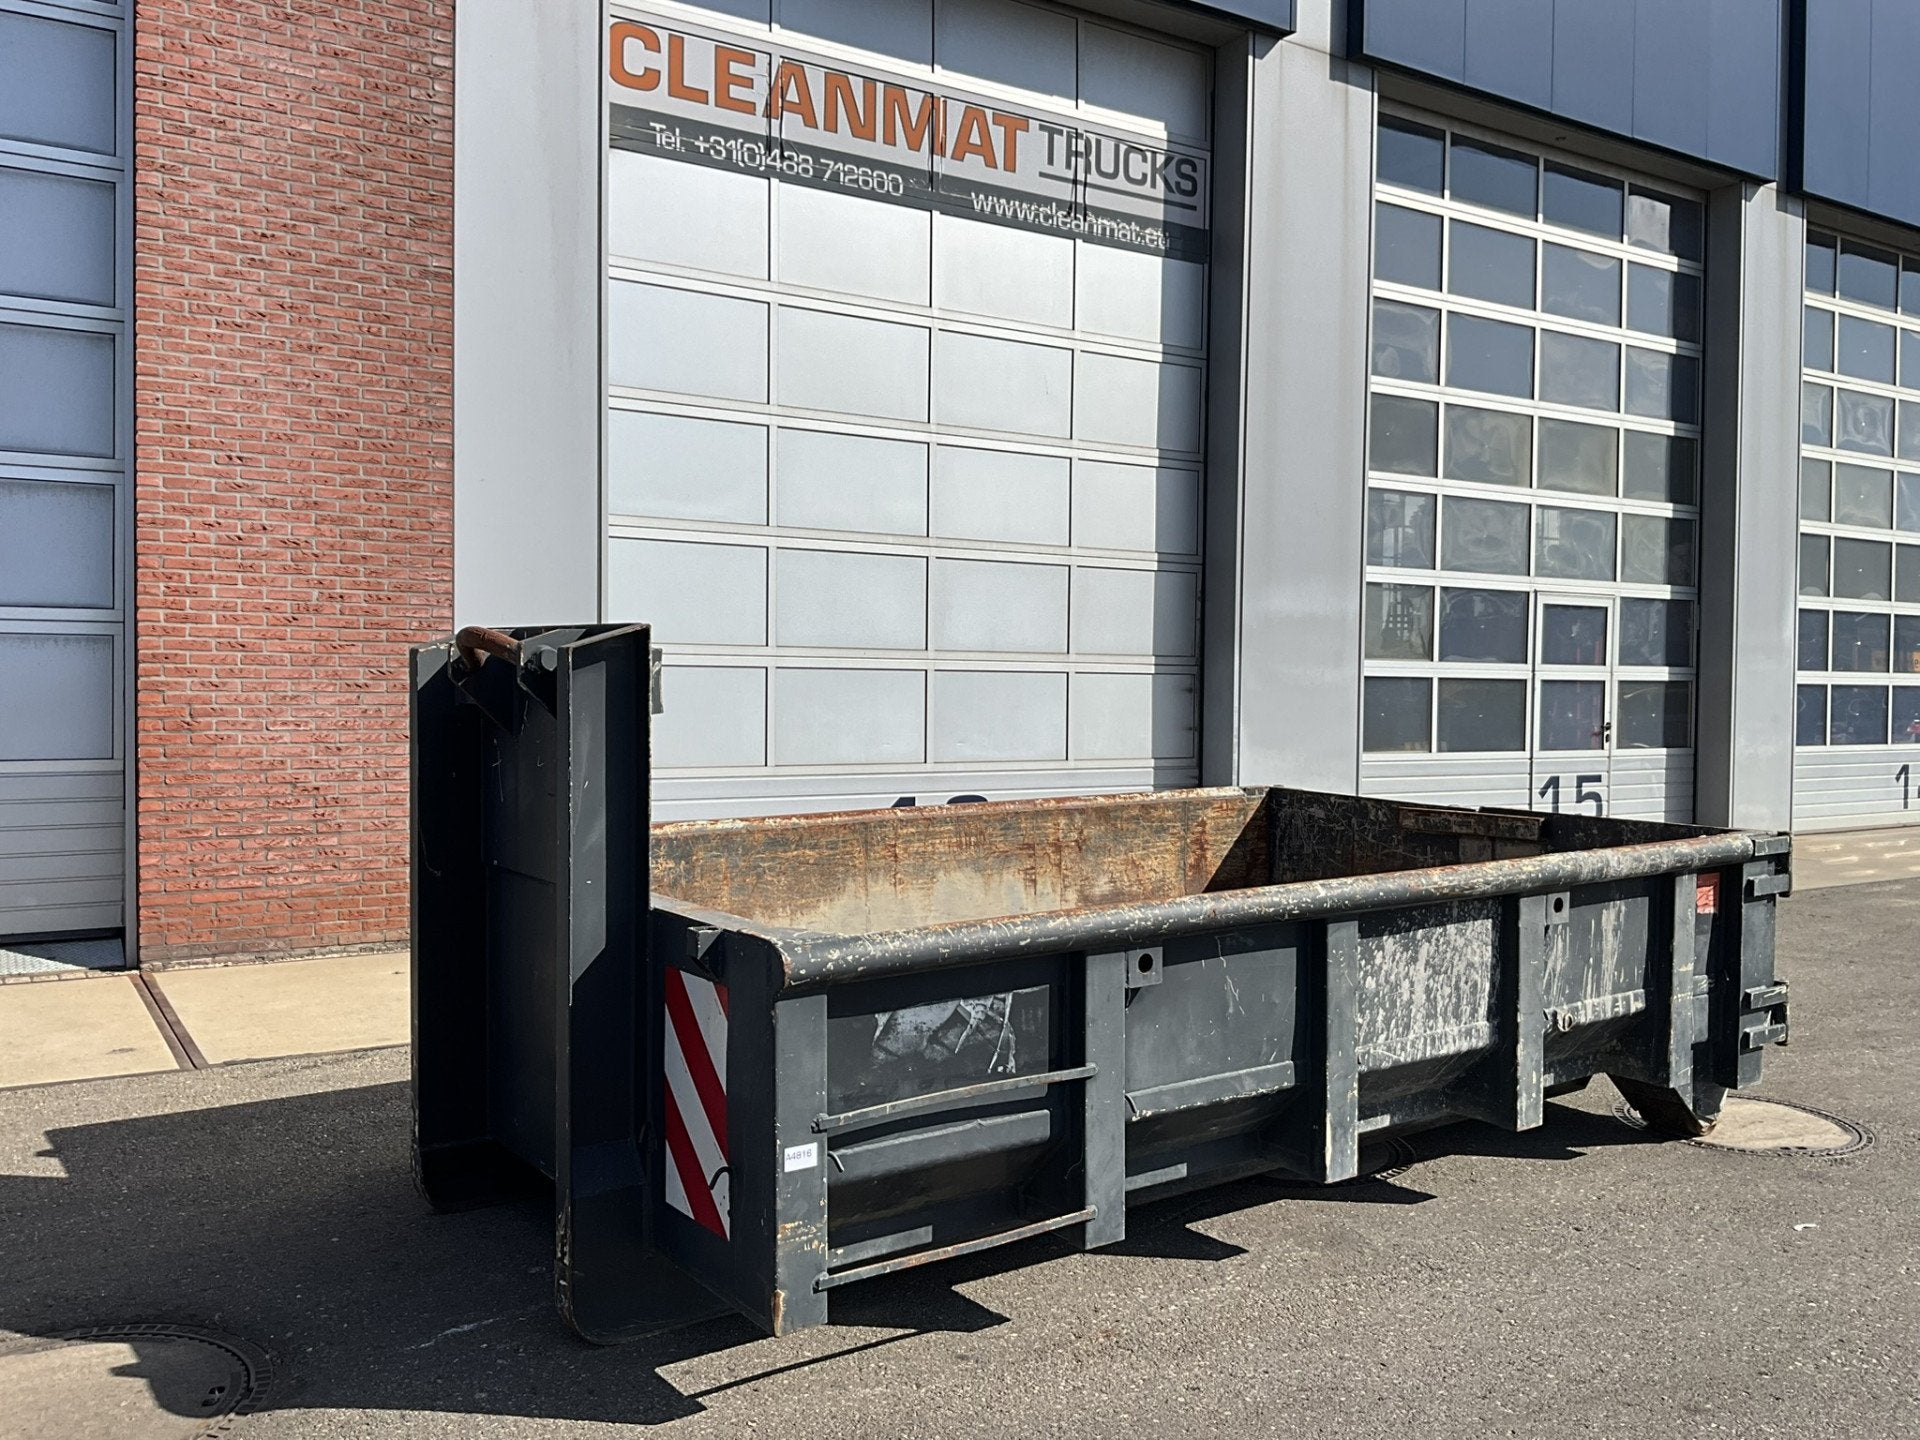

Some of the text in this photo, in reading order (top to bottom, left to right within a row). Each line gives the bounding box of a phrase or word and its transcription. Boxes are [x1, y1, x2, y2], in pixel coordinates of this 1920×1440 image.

[609, 21, 1198, 198] CLEANMAT TRUCKS
[649, 121, 686, 153] Tel.
[819, 158, 904, 196] 712600
[1538, 774, 1603, 816] 15
[1895, 764, 1920, 809] 1
